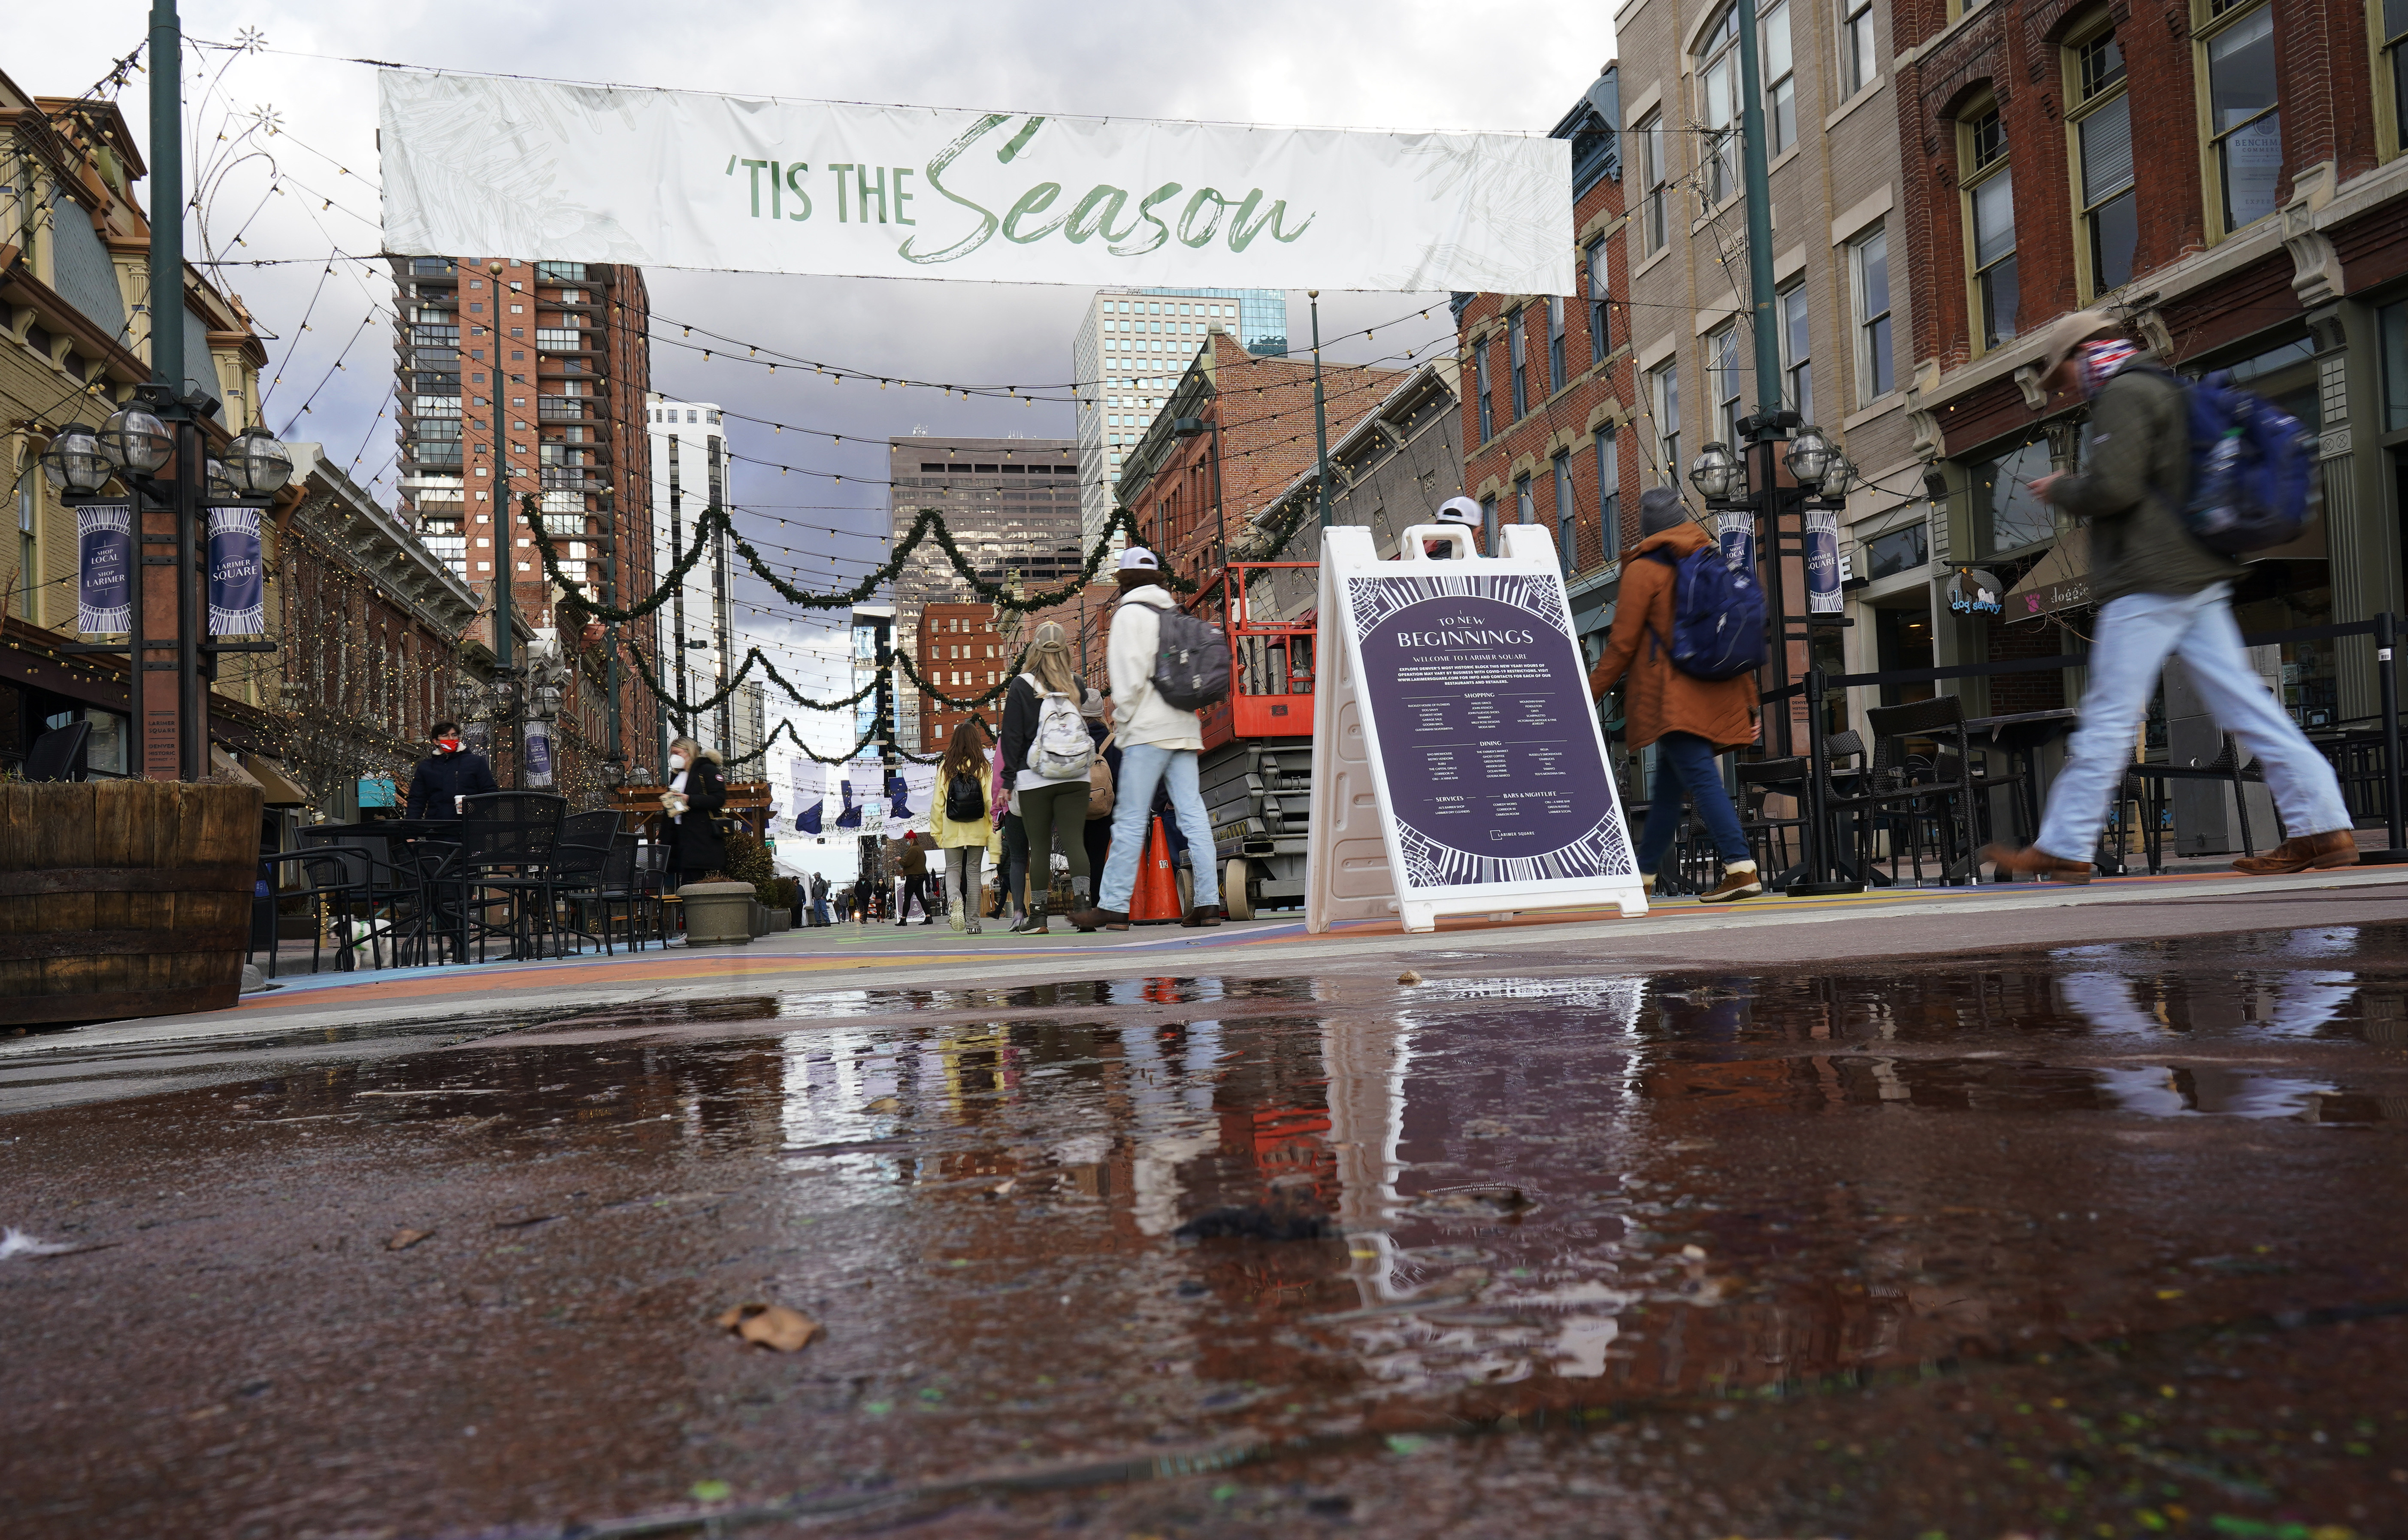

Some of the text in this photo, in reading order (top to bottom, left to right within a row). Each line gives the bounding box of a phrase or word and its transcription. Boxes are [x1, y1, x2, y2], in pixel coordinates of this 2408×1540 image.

[726, 115, 1316, 263] 'TIS THE Season
[91, 554, 119, 564] LOCAL
[1727, 549, 1745, 559] LOCAL
[1808, 552, 1831, 562] LARIMER
[217, 559, 251, 571] LARIMER
[213, 565, 258, 582] SQUARE
[87, 574, 125, 587] LARIMER
[2051, 583, 2089, 604] doggie
[1952, 590, 2002, 614] dog savvy
[1436, 616, 1487, 626] TO NEW
[1397, 629, 1534, 647] BEGINNINGS
[821, 823, 835, 833] RRY
